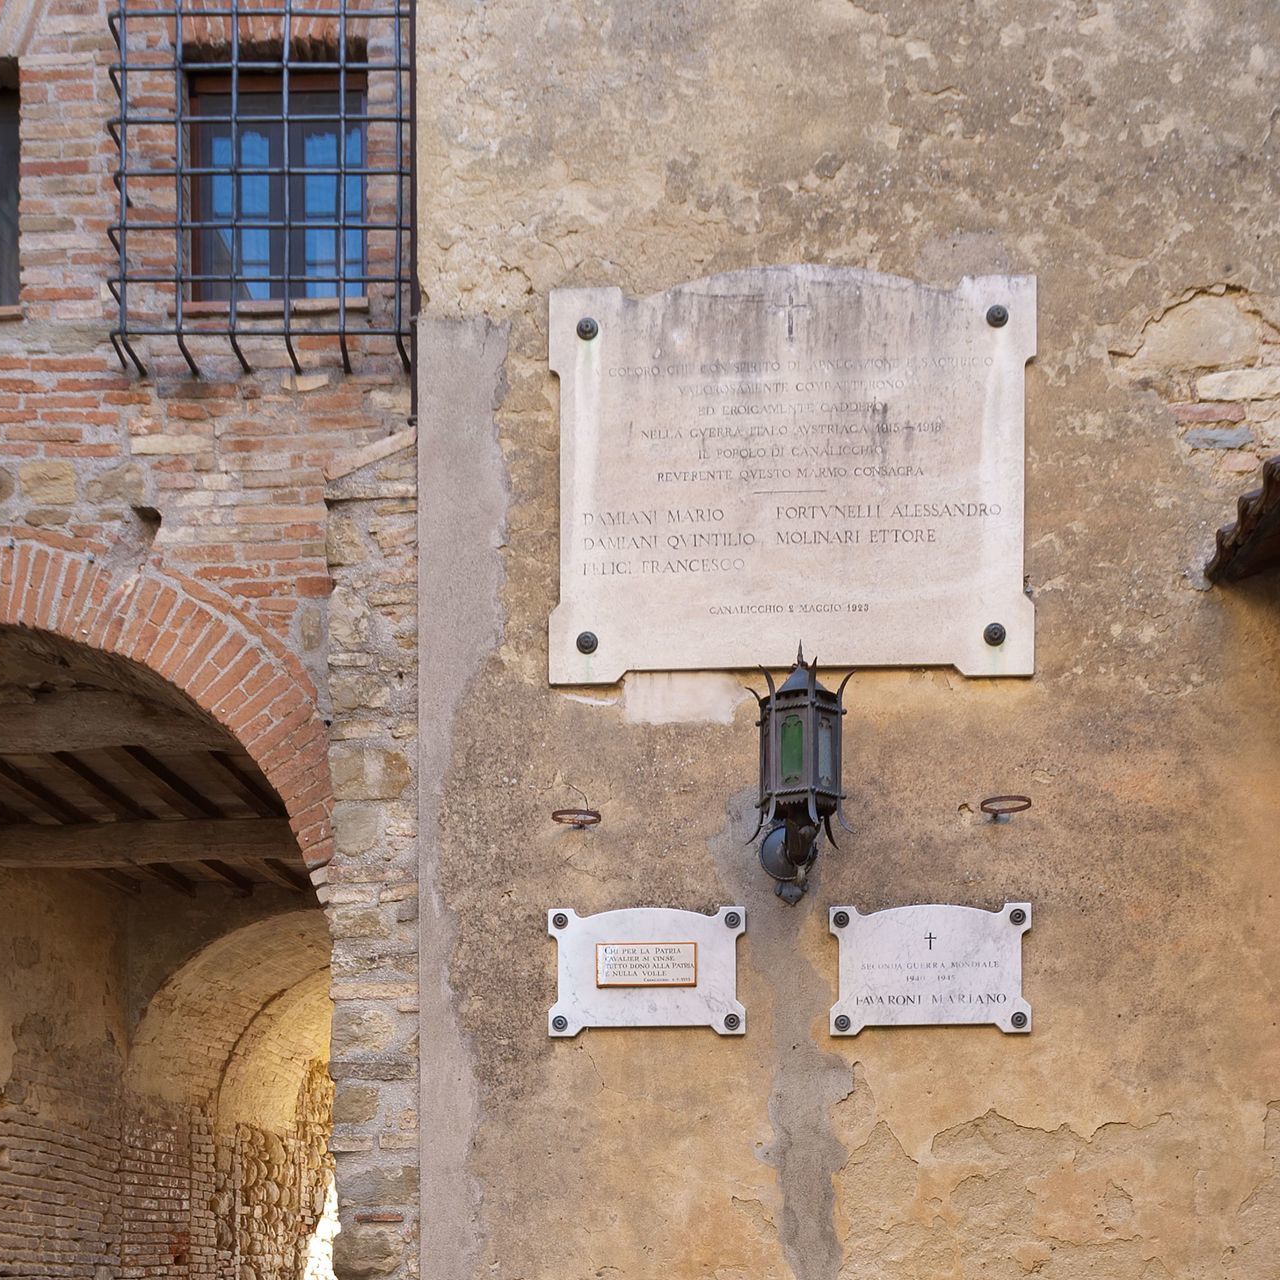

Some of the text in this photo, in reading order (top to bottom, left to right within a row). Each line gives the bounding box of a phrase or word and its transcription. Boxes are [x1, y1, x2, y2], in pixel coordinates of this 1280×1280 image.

[608, 365, 661, 377] COLORO
[700, 363, 727, 374] CON
[734, 361, 781, 374] SPIRITO
[787, 360, 801, 370] DI
[922, 357, 994, 368] SACRIFICIO
[678, 379, 905, 396] VALOROSAMENTE COMBATTERONO
[698, 401, 885, 417] ED EROICAMENTE CADDERO
[641, 429, 683, 440] NELLA
[690, 426, 742, 439] GVERRA
[748, 425, 788, 437] ITALO
[796, 423, 868, 435] AVSTRIACA
[698, 444, 884, 460] IL POPOLO DI CANALICCHIO
[657, 465, 925, 483] REVERENTE QVESTO MARMO CONSACRA
[583, 508, 725, 526] DAMIANI MARIO
[776, 503, 1002, 520] FORTVNELLI ALESSANDRO
[583, 532, 756, 551] DAMIANI QVINTILIO
[776, 528, 936, 545] MOLINARI ETTORE
[583, 558, 746, 576] FELICI FRANCESCO
[709, 604, 784, 616] CANALICCHIO
[800, 603, 842, 614] MAGGIO
[604, 947, 619, 955] CHI
[861, 960, 1000, 970] SECONDA GUERRA MONDIALE
[856, 992, 1007, 1006] FAVARONI MARIANO
